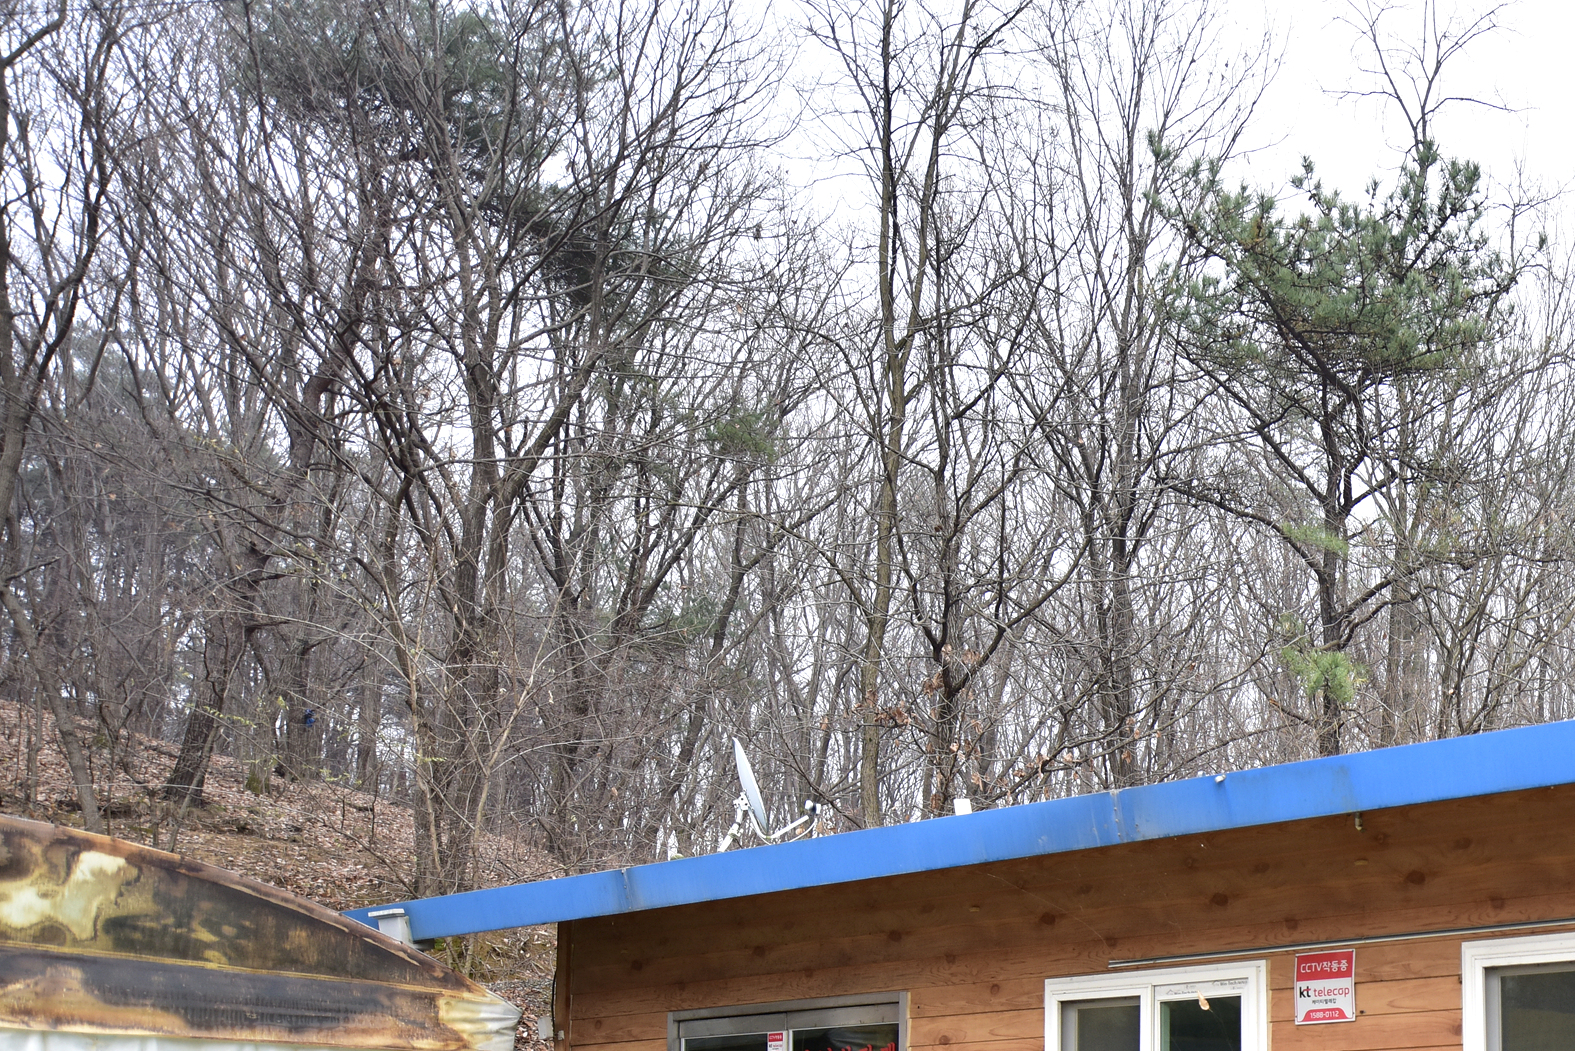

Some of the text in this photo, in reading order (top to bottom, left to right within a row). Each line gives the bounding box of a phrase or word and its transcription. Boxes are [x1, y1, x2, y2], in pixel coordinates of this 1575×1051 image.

[1300, 959, 1349, 973] CCTV작동중
[1299, 986, 1350, 998] kt telecop
[1309, 1010, 1340, 1019] 1588-0112
